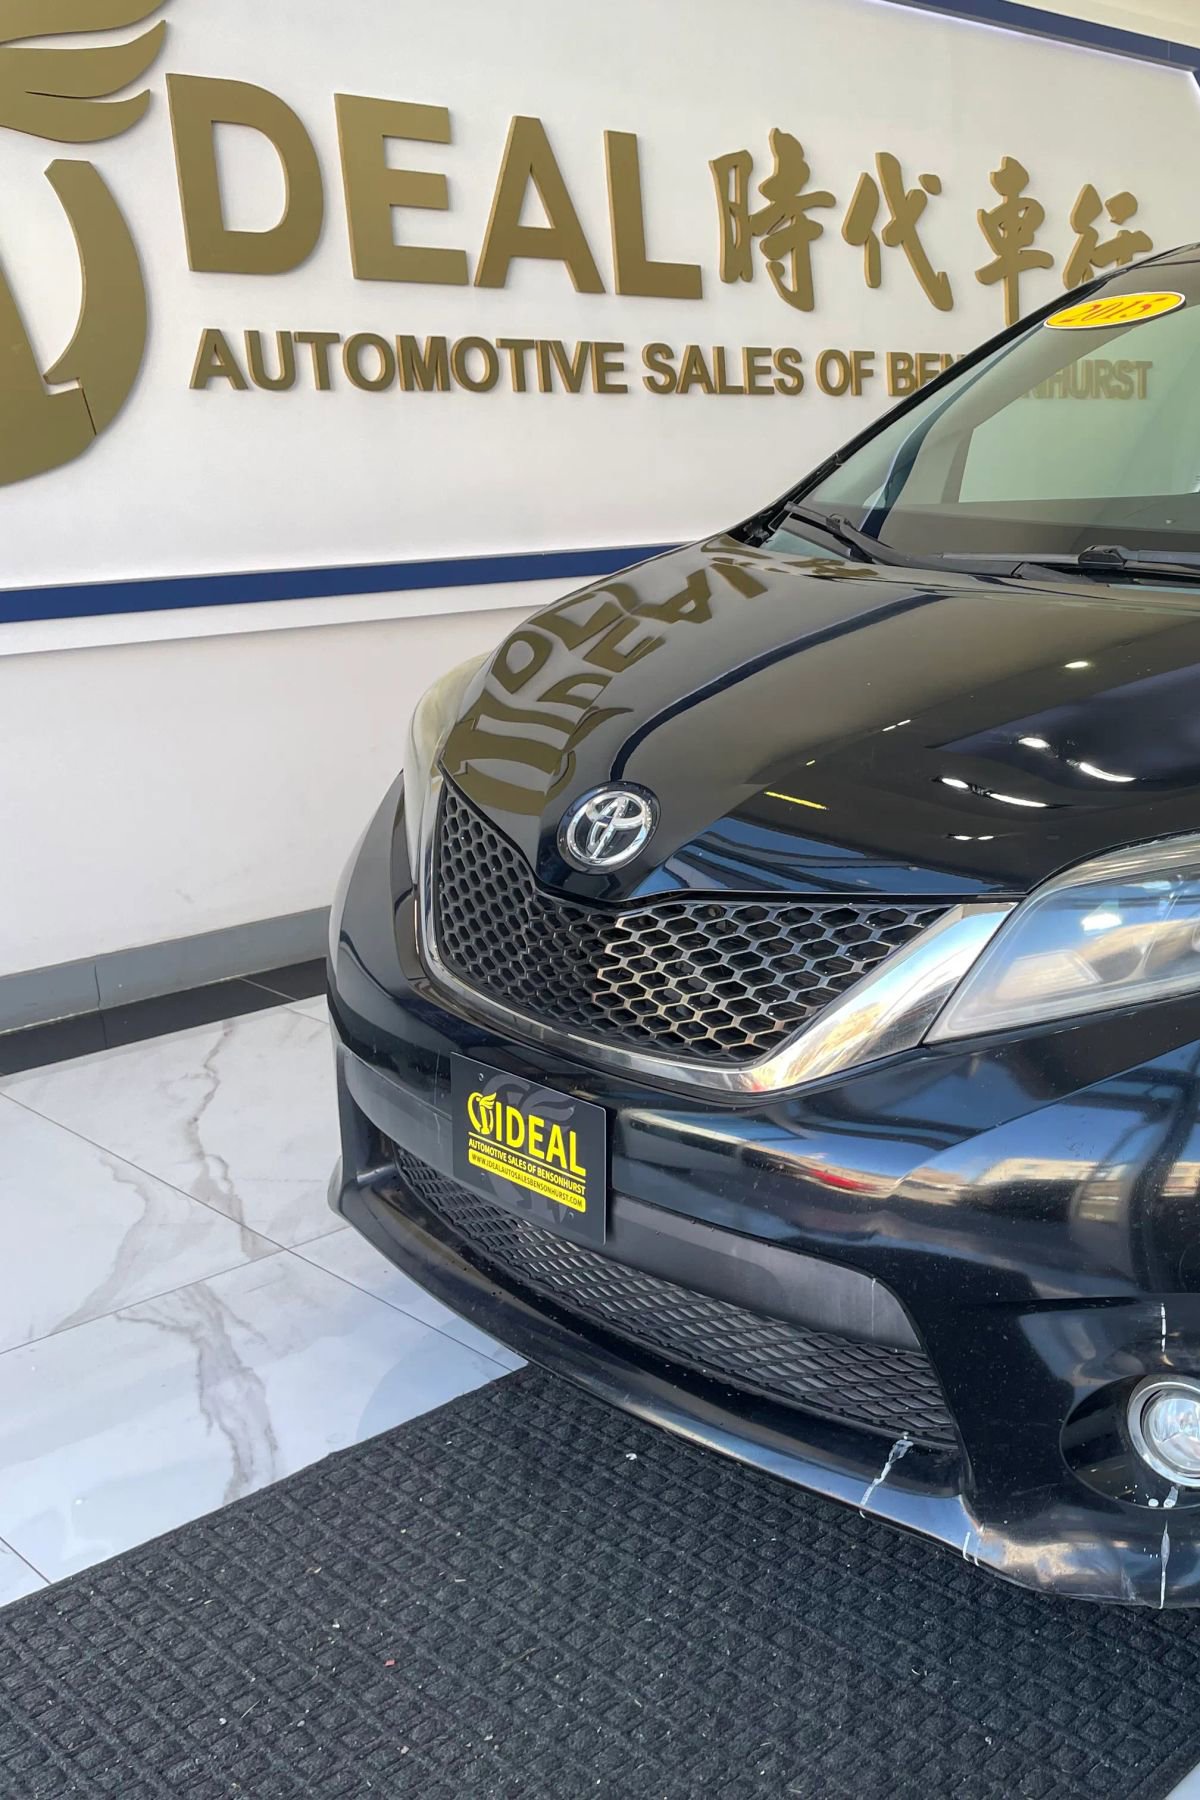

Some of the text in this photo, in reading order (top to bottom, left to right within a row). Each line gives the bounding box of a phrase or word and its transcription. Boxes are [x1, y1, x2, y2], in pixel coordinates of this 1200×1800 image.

[709, 127, 1153, 328] 時代車行
[1056, 296, 1169, 323] 2015
[189, 328, 628, 394] AUTOMOTIVE
[642, 342, 804, 396] SALES
[815, 348, 874, 398] OF
[468, 1138, 586, 1196] AUTOMOTIVE SALES OF BENSONHURST
[496, 1102, 586, 1177] IDEAL
[471, 1153, 583, 1208] WWW.IDEALAUTOSALESBENSONHURST.COM
